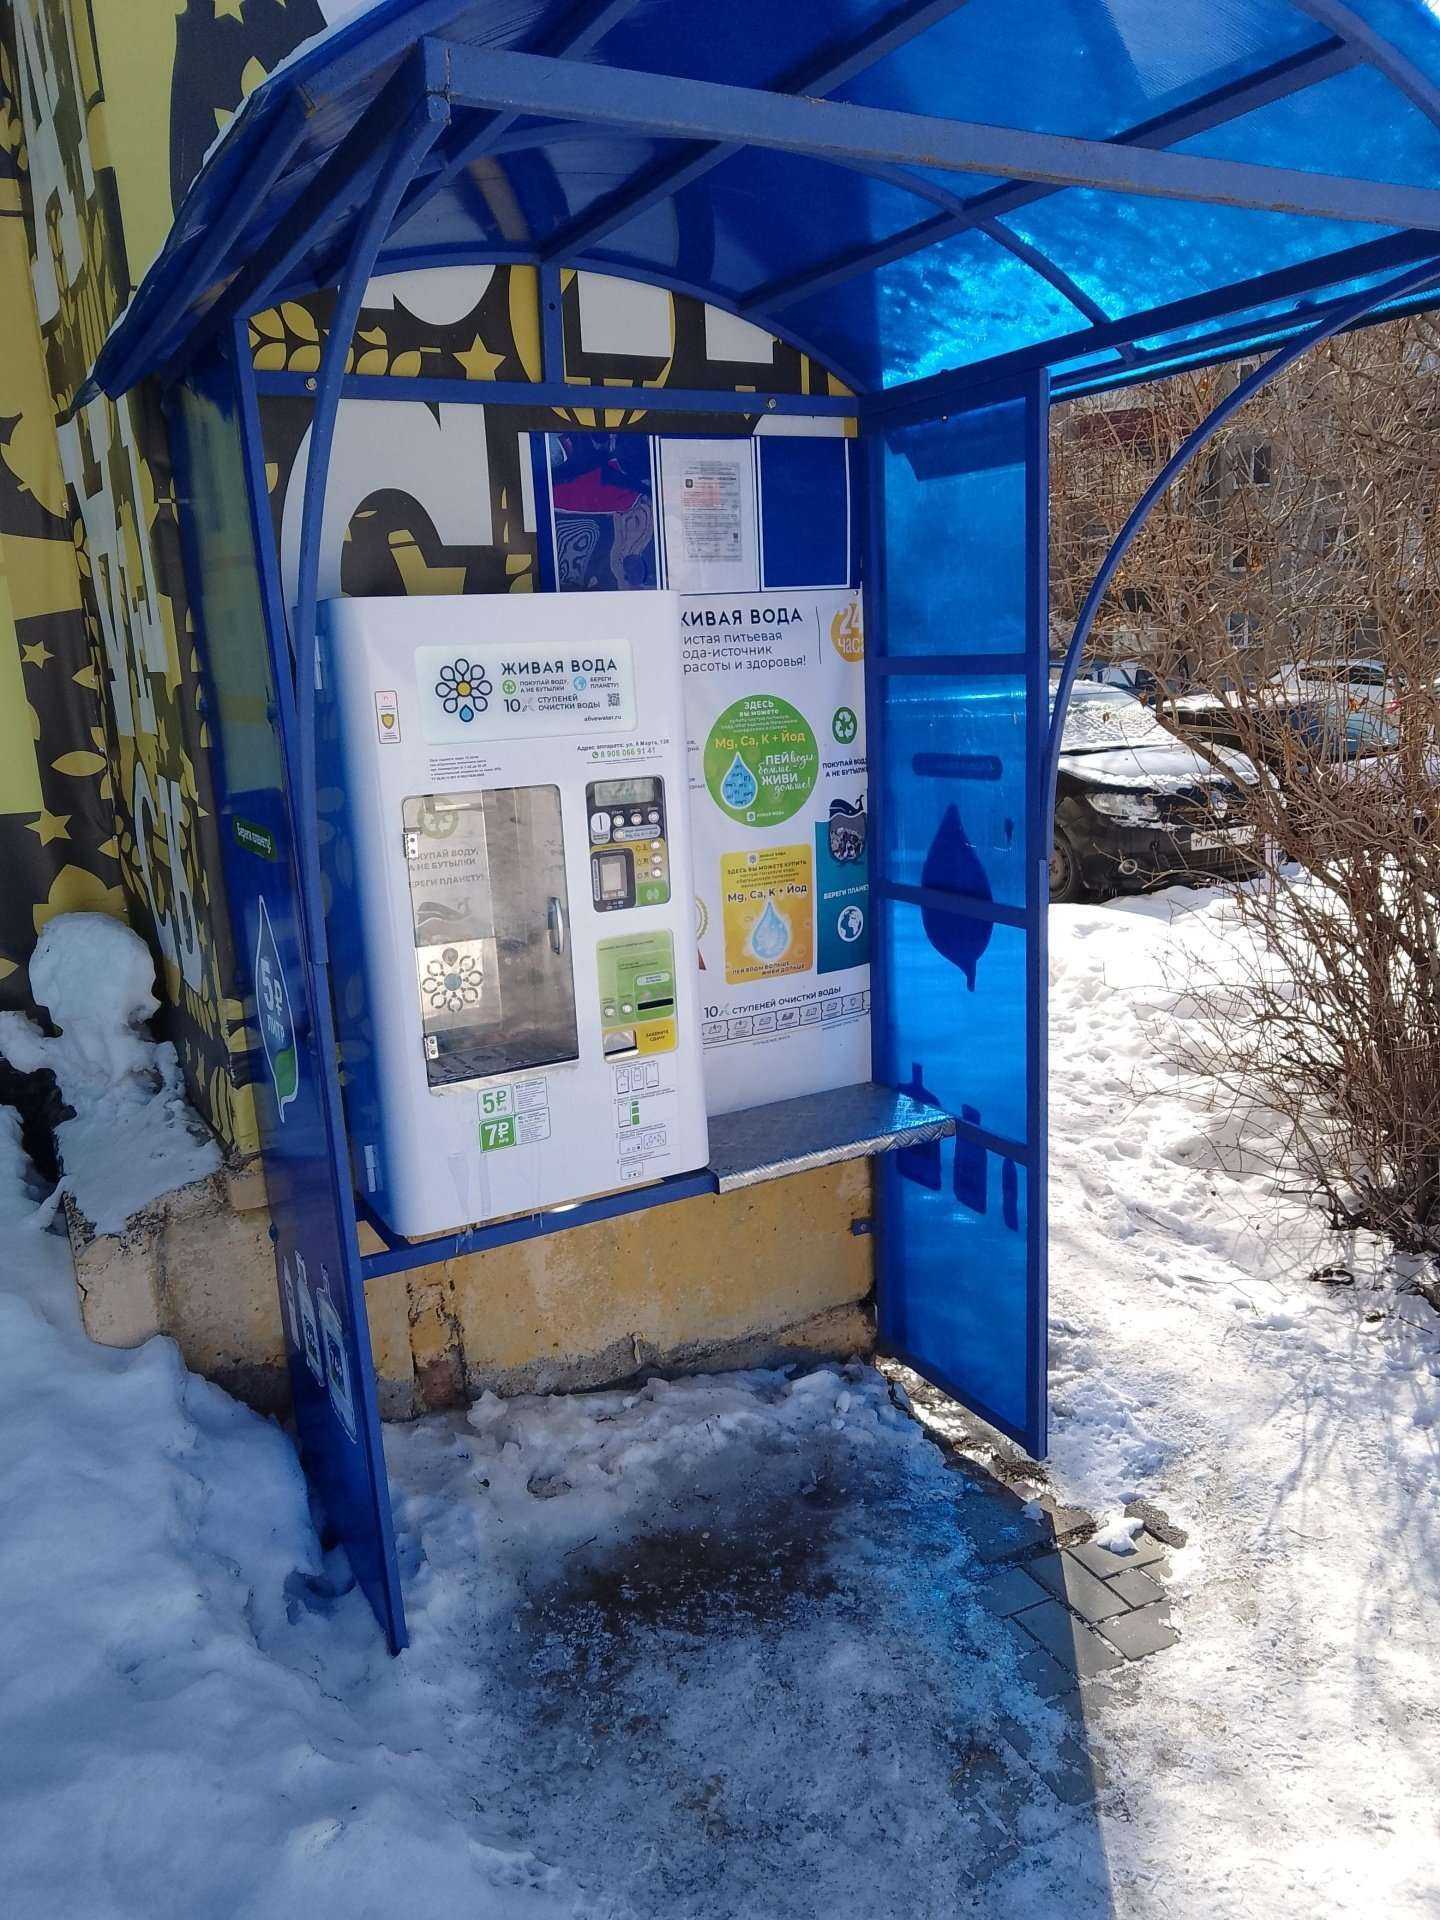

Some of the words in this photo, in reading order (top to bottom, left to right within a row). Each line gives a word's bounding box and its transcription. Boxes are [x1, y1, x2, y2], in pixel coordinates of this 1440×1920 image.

[750, 607, 803, 625] ВОДА
[683, 633, 721, 645] истая
[724, 631, 783, 643] питьевая
[682, 646, 773, 661] ода-источник
[501, 660, 564, 675] ЖИВАЯ
[571, 657, 618, 673] ВОДА
[683, 660, 731, 676] расоты
[747, 655, 807, 672] здоровья!
[503, 698, 521, 712] 10
[538, 693, 578, 704] СТУПЕНЕЙ
[744, 700, 775, 710] ЗДЕСЬ
[538, 703, 576, 711] ОЧИСТКИ
[716, 738, 738, 750] Mg,
[741, 735, 759, 748] Ca,
[781, 729, 806, 743] Йод
[766, 751, 789, 765] ПЕЙ
[762, 773, 798, 786] ЖИВИ
[728, 893, 747, 903] Mg,
[749, 890, 766, 900] Ca,
[787, 882, 807, 894] Йод
[704, 1005, 718, 1018] 10
[732, 1001, 776, 1015] СТУПЕНЕЙ
[778, 992, 817, 1006] ОЧИСТКИ
[817, 986, 841, 998] ВОДЫ
